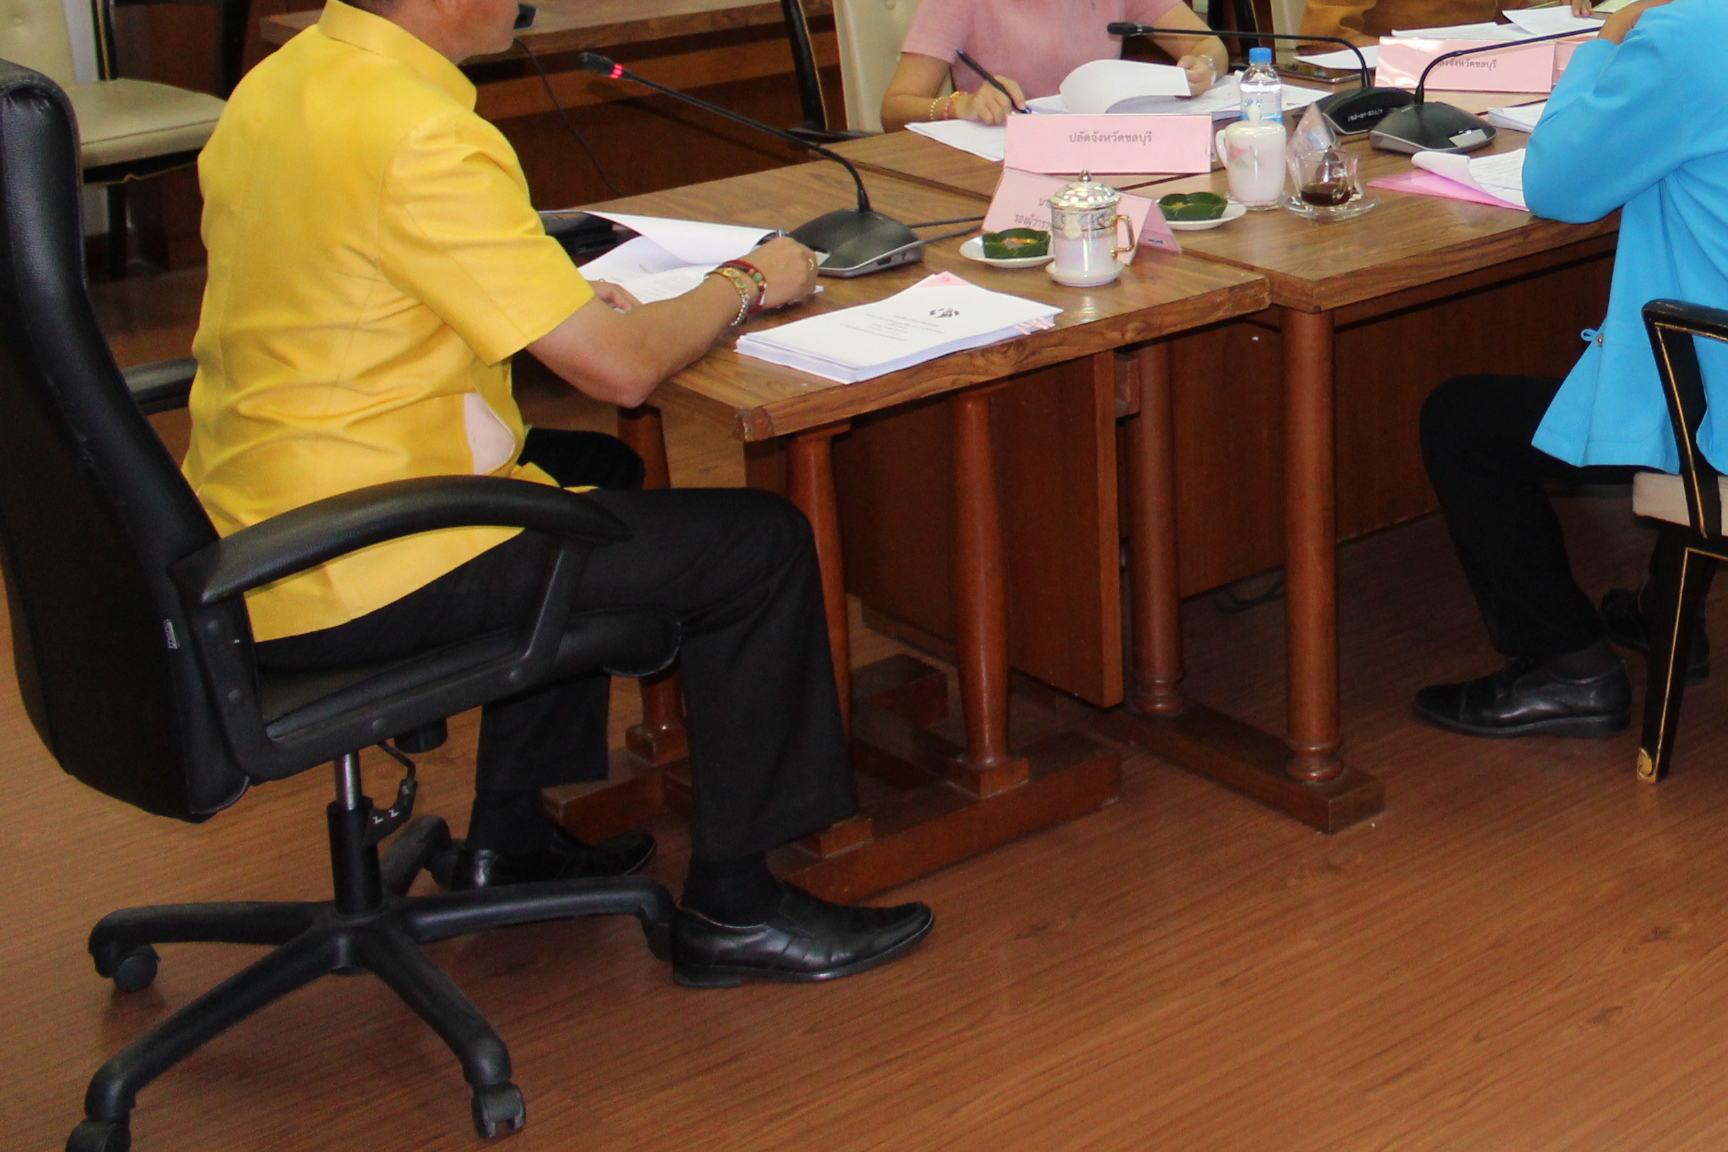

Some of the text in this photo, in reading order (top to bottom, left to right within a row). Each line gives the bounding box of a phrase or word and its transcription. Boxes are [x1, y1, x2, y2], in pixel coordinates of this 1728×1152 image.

[1068, 130, 1153, 146] ปลัดจังหวัดชลบุรี
